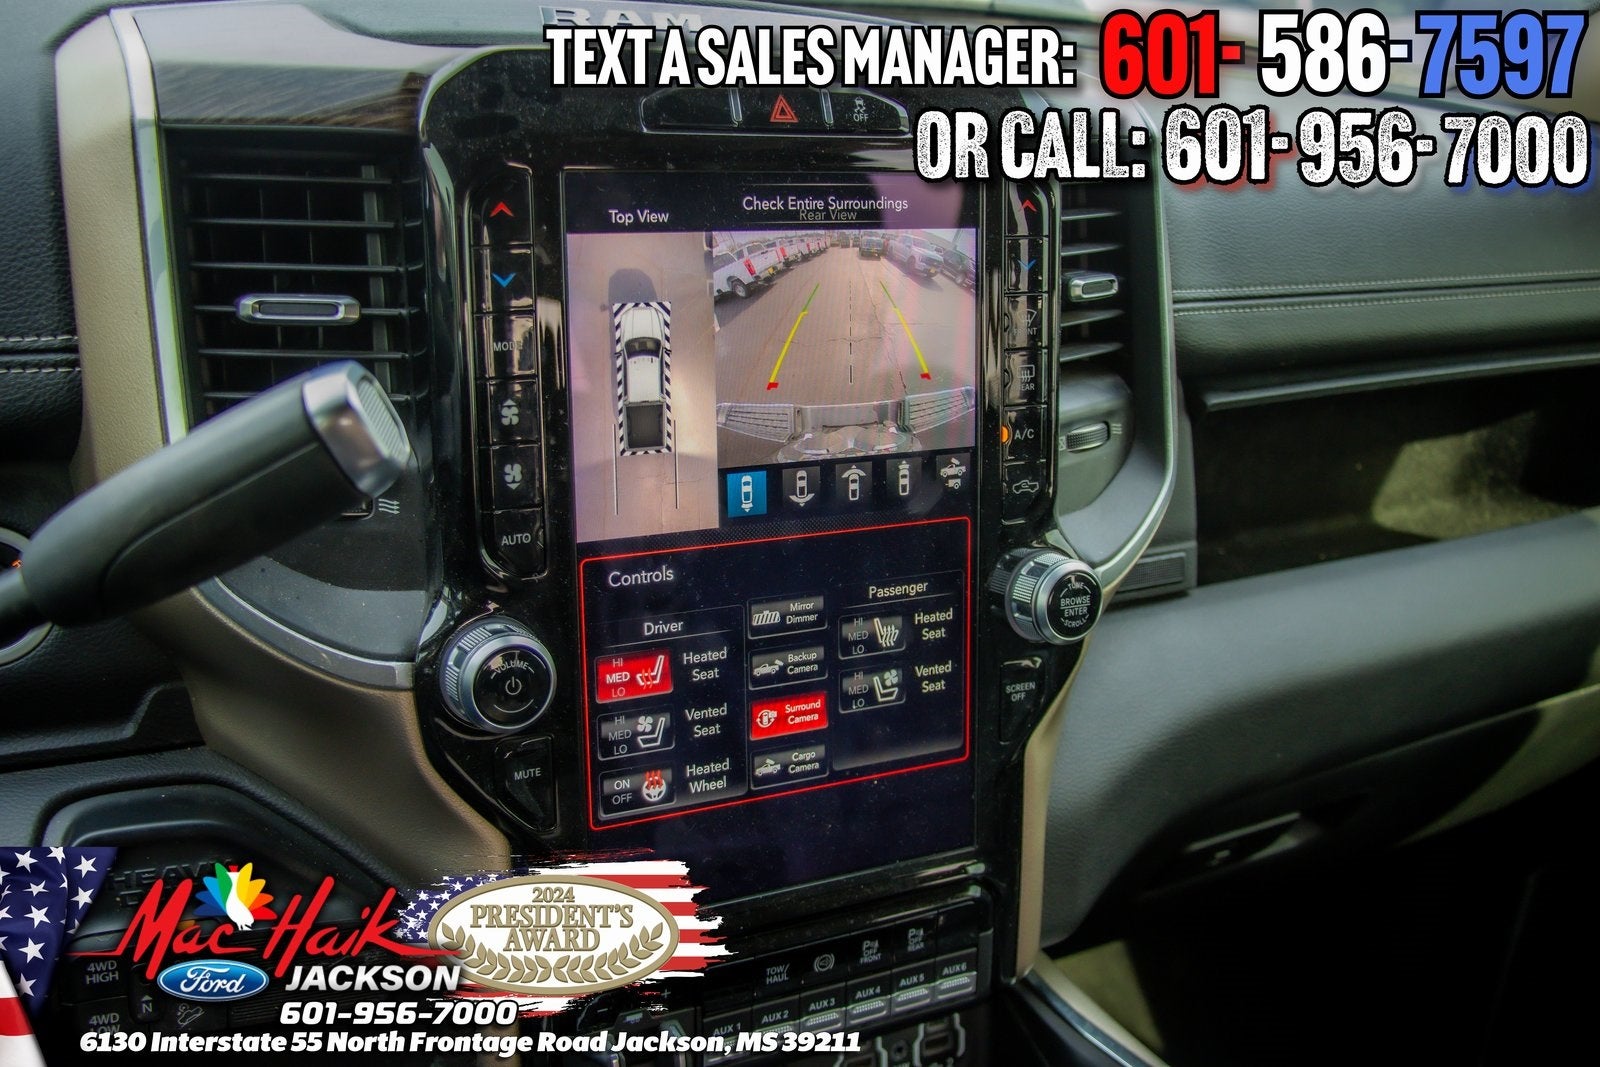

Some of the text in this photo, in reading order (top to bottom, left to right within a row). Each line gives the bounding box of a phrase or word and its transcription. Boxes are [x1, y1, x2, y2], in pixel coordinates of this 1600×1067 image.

[538, 6, 703, 32] RAM
[852, 112, 870, 122] OFF
[743, 195, 909, 213] Check Entire Surroundings
[608, 209, 670, 225] Top View
[799, 209, 857, 221] Rear View
[1014, 428, 1035, 441] A/C
[501, 533, 531, 546] AUTO
[608, 565, 674, 588] Controls
[868, 581, 929, 599] Passenger
[790, 601, 815, 612] Mirror
[1060, 594, 1091, 607] BROWSE
[914, 607, 953, 625] Heated
[1064, 607, 1088, 617] ENTER
[786, 613, 818, 625] Dimmer
[853, 617, 864, 627] HI
[1063, 617, 1087, 628] SCROLL
[644, 620, 684, 636] Driver
[921, 626, 946, 641] Seat
[848, 631, 869, 642] MED
[683, 646, 728, 665] Heated
[852, 645, 865, 655] LO
[612, 658, 624, 669] HI
[788, 651, 818, 663] Backup
[494, 659, 529, 674] VOLUME
[787, 663, 819, 675] Camera
[914, 660, 952, 678] Vented
[606, 671, 630, 684] MED
[692, 668, 720, 682] Seat
[853, 671, 864, 681] HI
[611, 687, 626, 698] LO
[848, 684, 869, 696] MED
[921, 679, 946, 694] Seat
[1005, 681, 1036, 693] SCREEN
[1011, 692, 1026, 702] OFF
[785, 699, 821, 713] Surround
[852, 699, 865, 709] LO
[685, 702, 728, 721] Vented
[614, 715, 625, 726] HI
[787, 713, 819, 725] Camera
[608, 729, 632, 741] MED
[693, 723, 721, 738] Seat
[613, 744, 628, 755] LO
[791, 751, 816, 763] Cargo
[686, 757, 730, 777] Heated
[787, 762, 820, 774] Camera
[514, 767, 542, 781] MUTE
[614, 778, 630, 790] ON
[689, 775, 727, 794] Wheel
[612, 792, 633, 805] OFF
[85, 960, 118, 974] 4WD
[766, 963, 790, 977] TOW/
[942, 962, 967, 976] AUX 6
[85, 970, 119, 985] HIGH
[766, 973, 789, 985] HAUL
[900, 973, 925, 987] AUX 5
[855, 985, 882, 999] AUX 4
[809, 997, 836, 1012] AUX 3
[88, 1011, 120, 1026] 4WD
[762, 1009, 789, 1023] AUX 2
[713, 1021, 742, 1036] AUX 1
